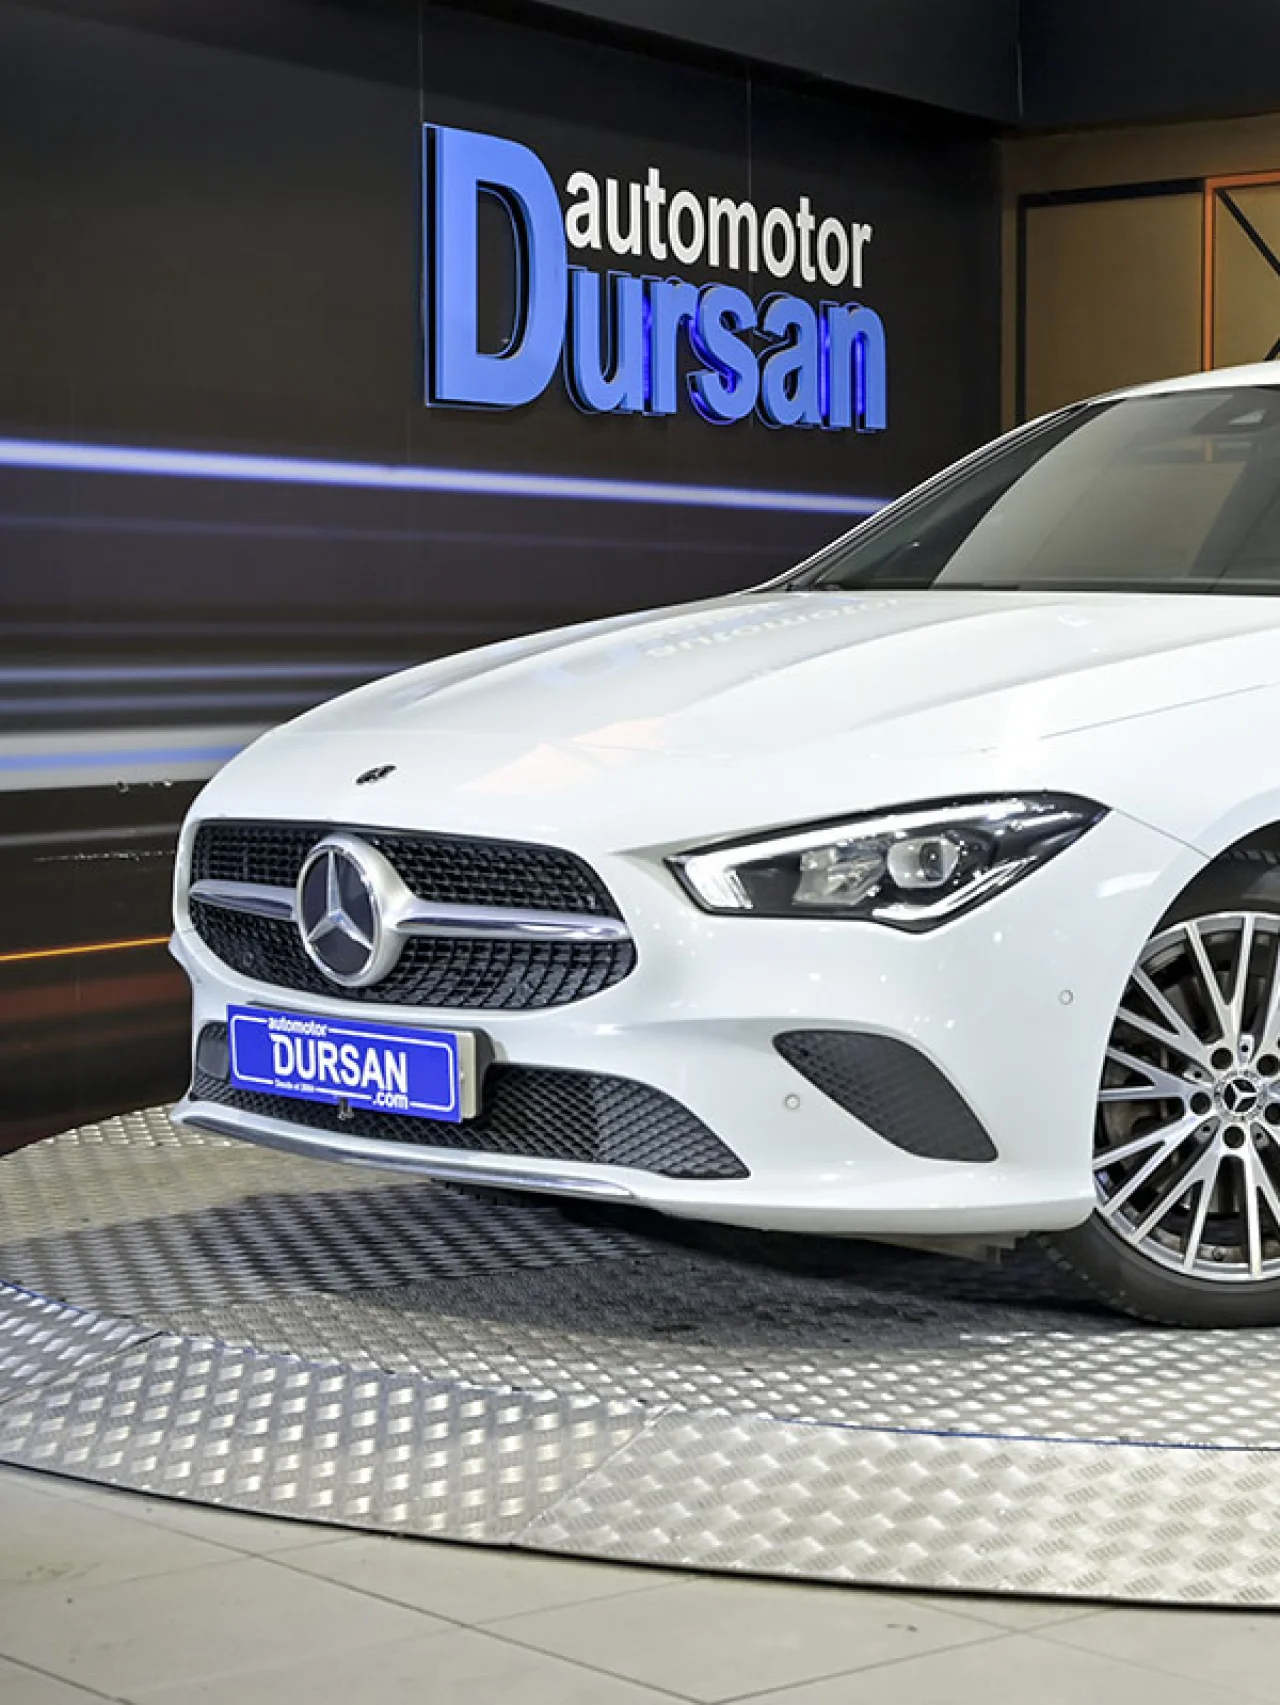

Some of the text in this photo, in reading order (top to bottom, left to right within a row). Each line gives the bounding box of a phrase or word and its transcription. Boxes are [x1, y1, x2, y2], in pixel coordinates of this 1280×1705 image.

[564, 167, 872, 288] automotor
[422, 122, 887, 433] Dursan
[268, 1017, 328, 1036] automotor
[269, 1032, 408, 1093] DURSAN
[373, 1092, 408, 1109] .com
